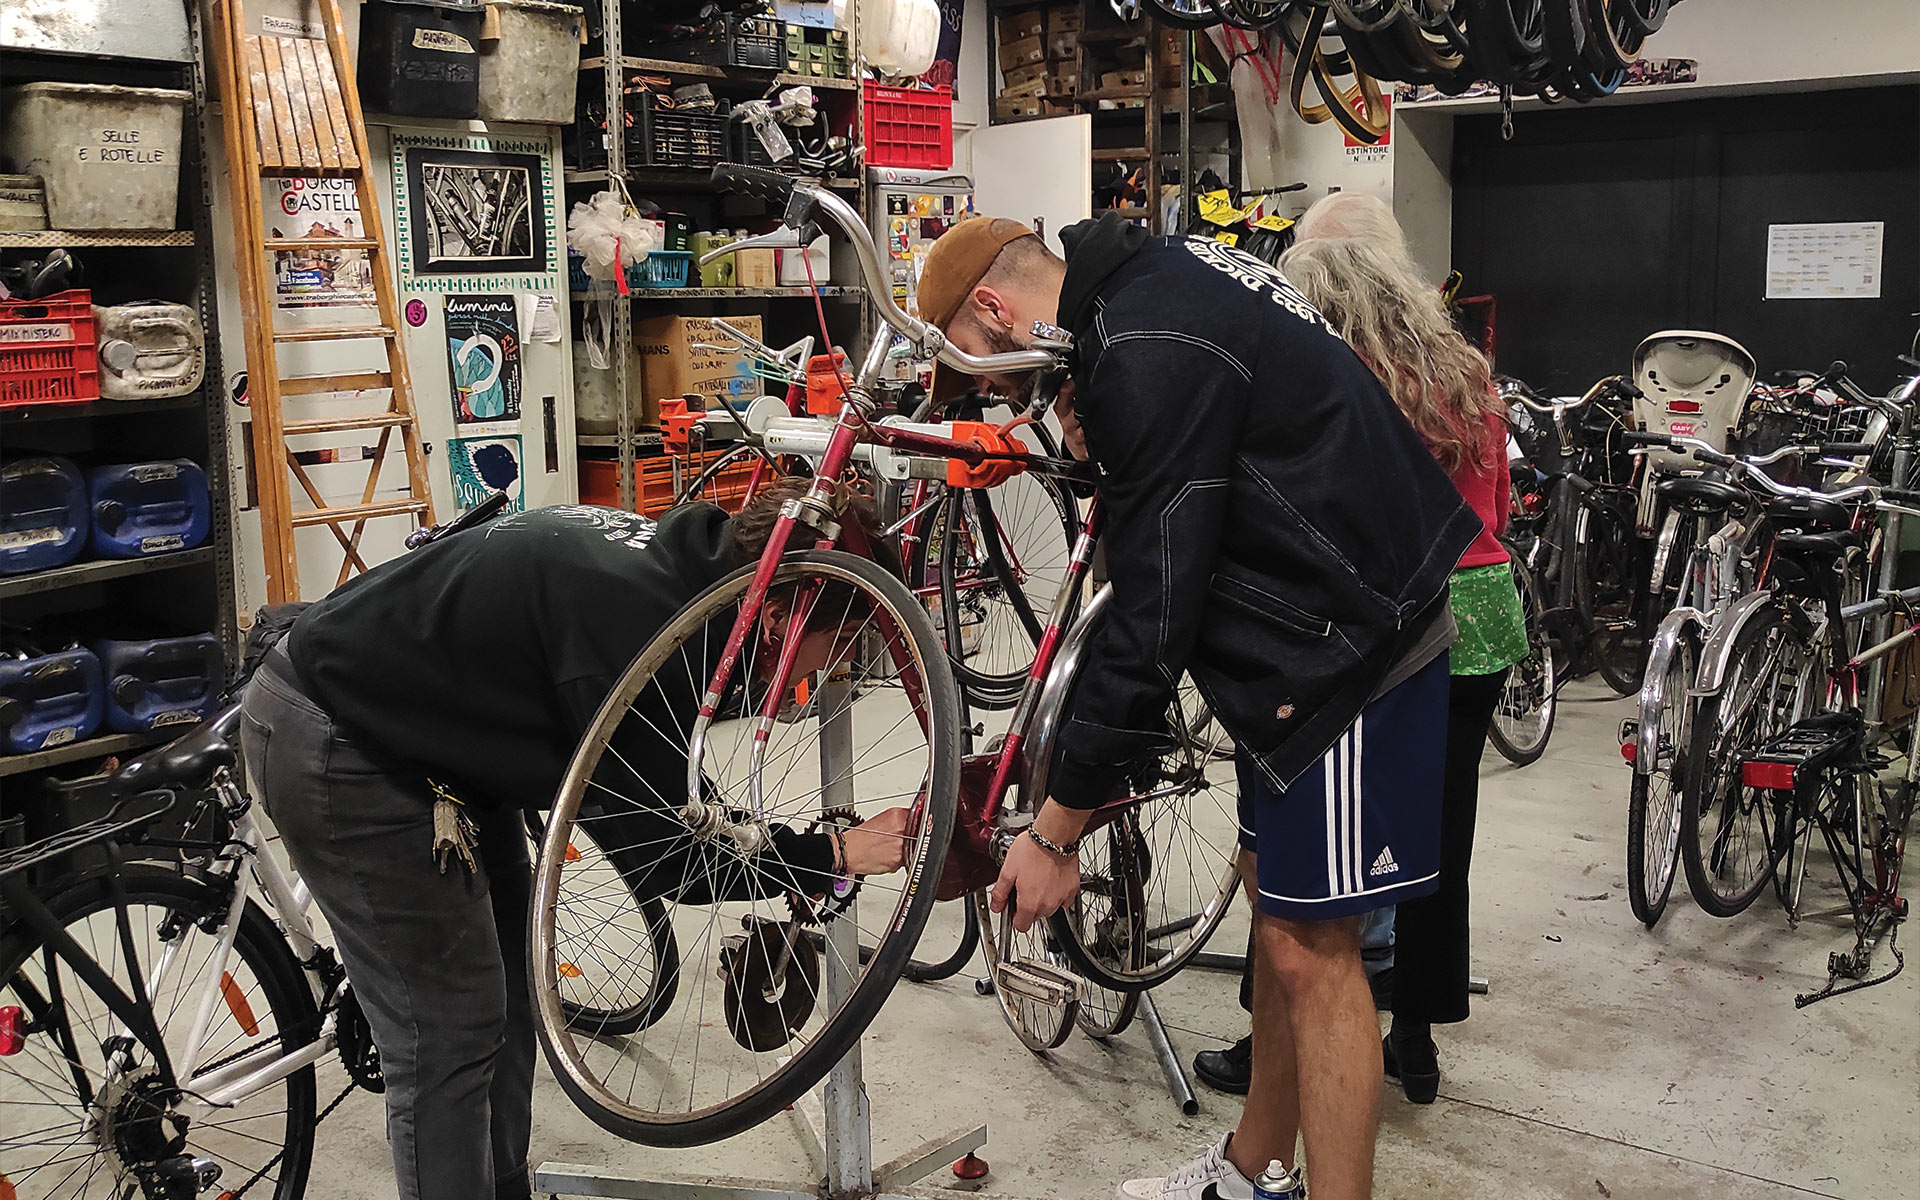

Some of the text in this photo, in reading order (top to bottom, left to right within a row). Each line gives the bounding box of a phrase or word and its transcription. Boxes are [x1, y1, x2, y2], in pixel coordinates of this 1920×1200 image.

[937, 0, 962, 32] ASS
[102, 130, 140, 143] SELLE
[79, 148, 165, 163] E ROTELLE
[1346, 146, 1389, 155] ESTINTORE
[293, 177, 355, 191] BORGH
[281, 190, 361, 216] CASTELL
[1271, 289, 1317, 324] 1922
[919, 836, 930, 862] GENERAL
[912, 864, 923, 883] STYLE
[1370, 862, 1399, 876] adidas
